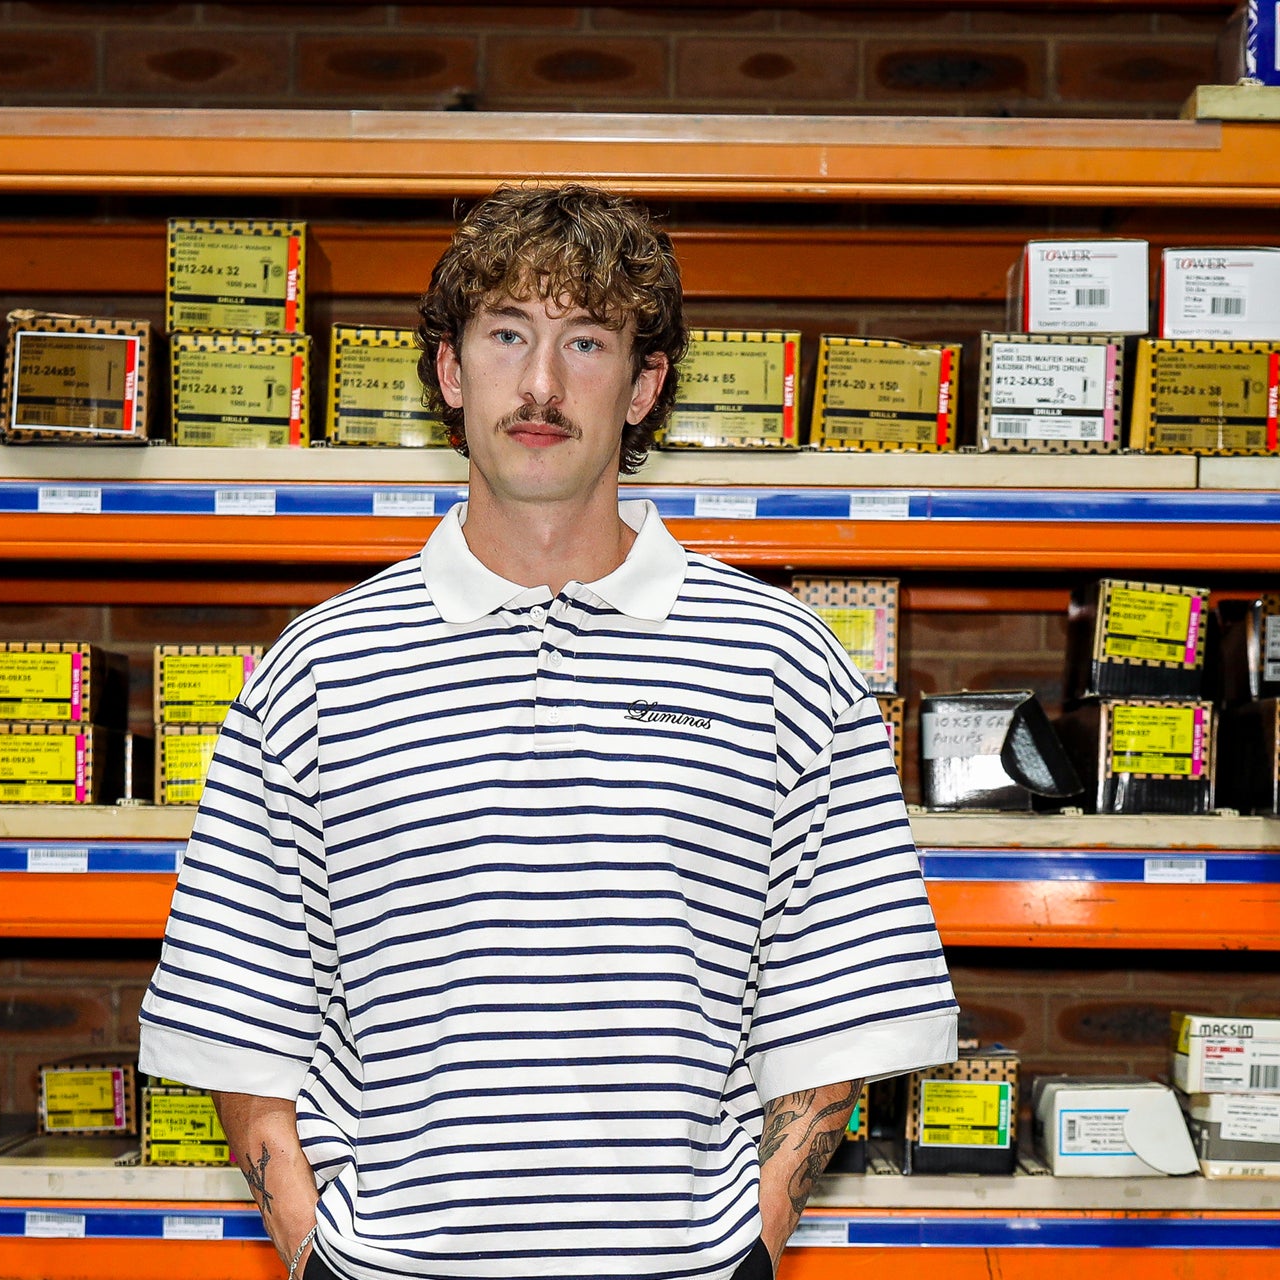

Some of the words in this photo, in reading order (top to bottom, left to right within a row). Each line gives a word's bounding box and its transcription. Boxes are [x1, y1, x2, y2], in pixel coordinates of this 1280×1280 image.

[1040, 250, 1091, 262] TOWER
[177, 264, 215, 274] #12-24
[226, 266, 239, 276] 32
[1174, 257, 1226, 270] TOWER
[288, 268, 297, 301] METAL
[343, 379, 378, 388] #12-24
[392, 380, 405, 390] 50
[722, 374, 736, 383] 85
[829, 379, 867, 390] #14-20
[879, 381, 897, 391] 150
[125, 371, 134, 401] METAL
[181, 383, 218, 394] #12-24
[229, 385, 243, 395] 32
[784, 374, 793, 407] METAL
[291, 388, 301, 420] METAL
[939, 381, 948, 414] METAL
[1268, 385, 1278, 418] METAL
[624, 700, 712, 729] Luminos
[1199, 1024, 1254, 1038] MACSIM
